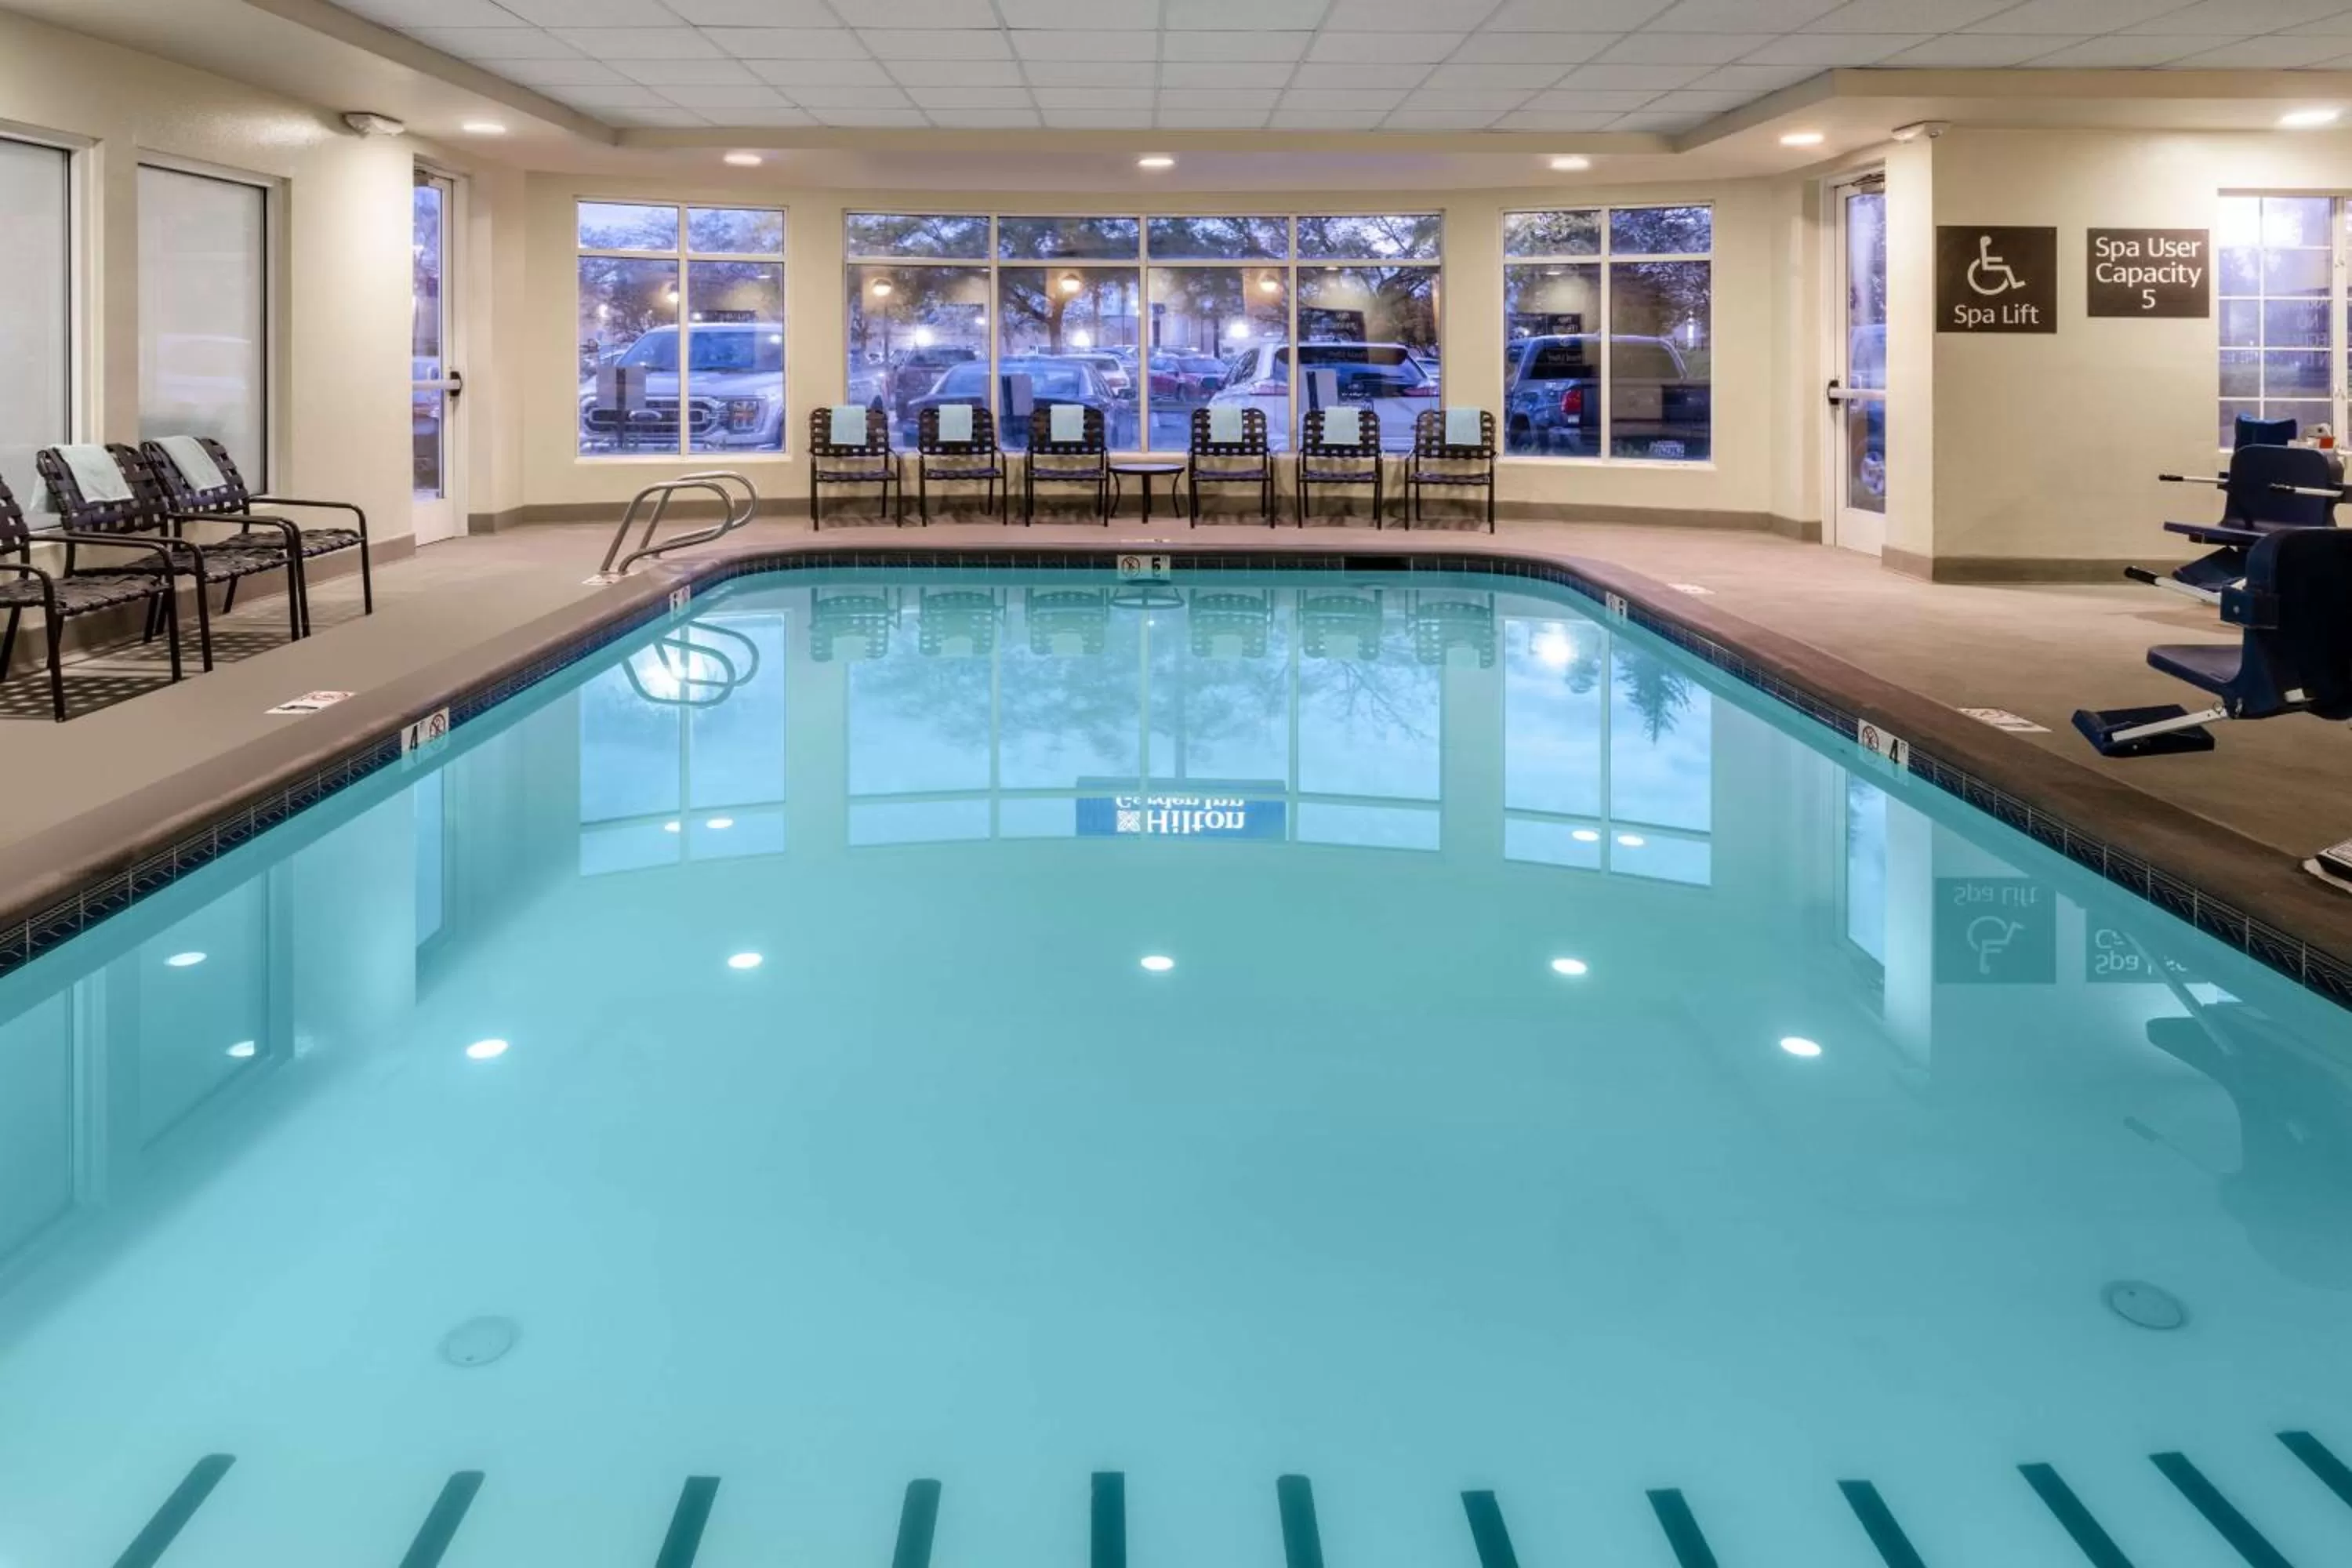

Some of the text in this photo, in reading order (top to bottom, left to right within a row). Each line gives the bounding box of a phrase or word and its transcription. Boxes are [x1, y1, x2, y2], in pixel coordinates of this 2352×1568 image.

[2095, 237, 2200, 261] Spa User
[2095, 262, 2201, 288] Capacity
[2141, 289, 2156, 310] 5
[1954, 304, 2039, 328] Spa Lift
